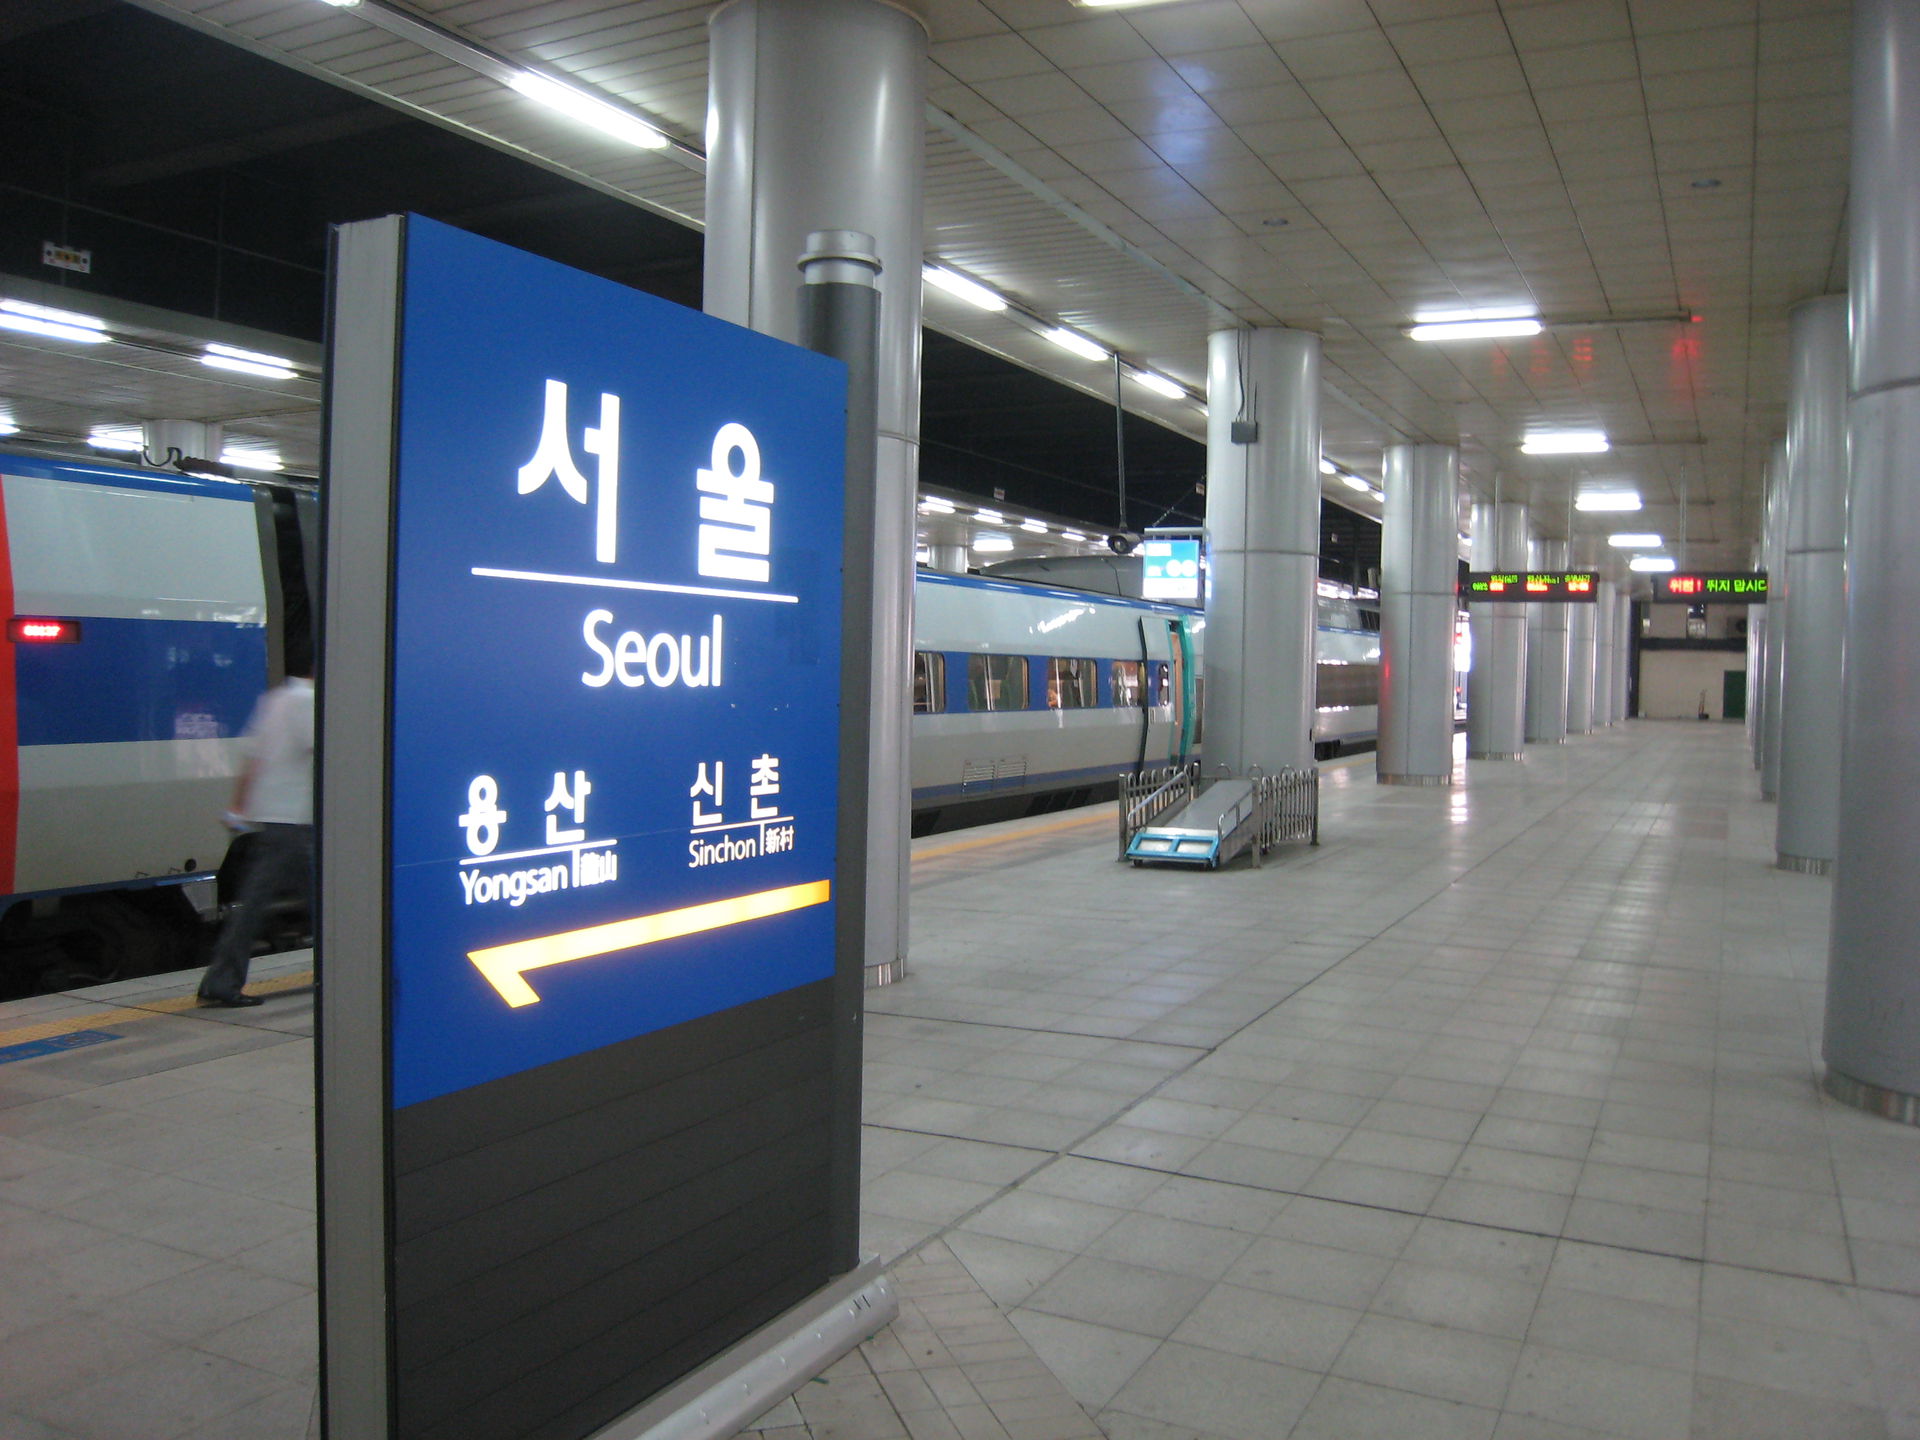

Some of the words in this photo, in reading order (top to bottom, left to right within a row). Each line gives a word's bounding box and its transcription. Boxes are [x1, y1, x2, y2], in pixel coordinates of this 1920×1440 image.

[517, 378, 774, 583] 서울
[581, 608, 722, 688] Seoul
[458, 769, 592, 856] 용산
[690, 753, 780, 828] 신촌
[688, 834, 756, 868] Sinchon
[765, 824, 795, 855] 新村
[458, 863, 568, 907] Yongsan
